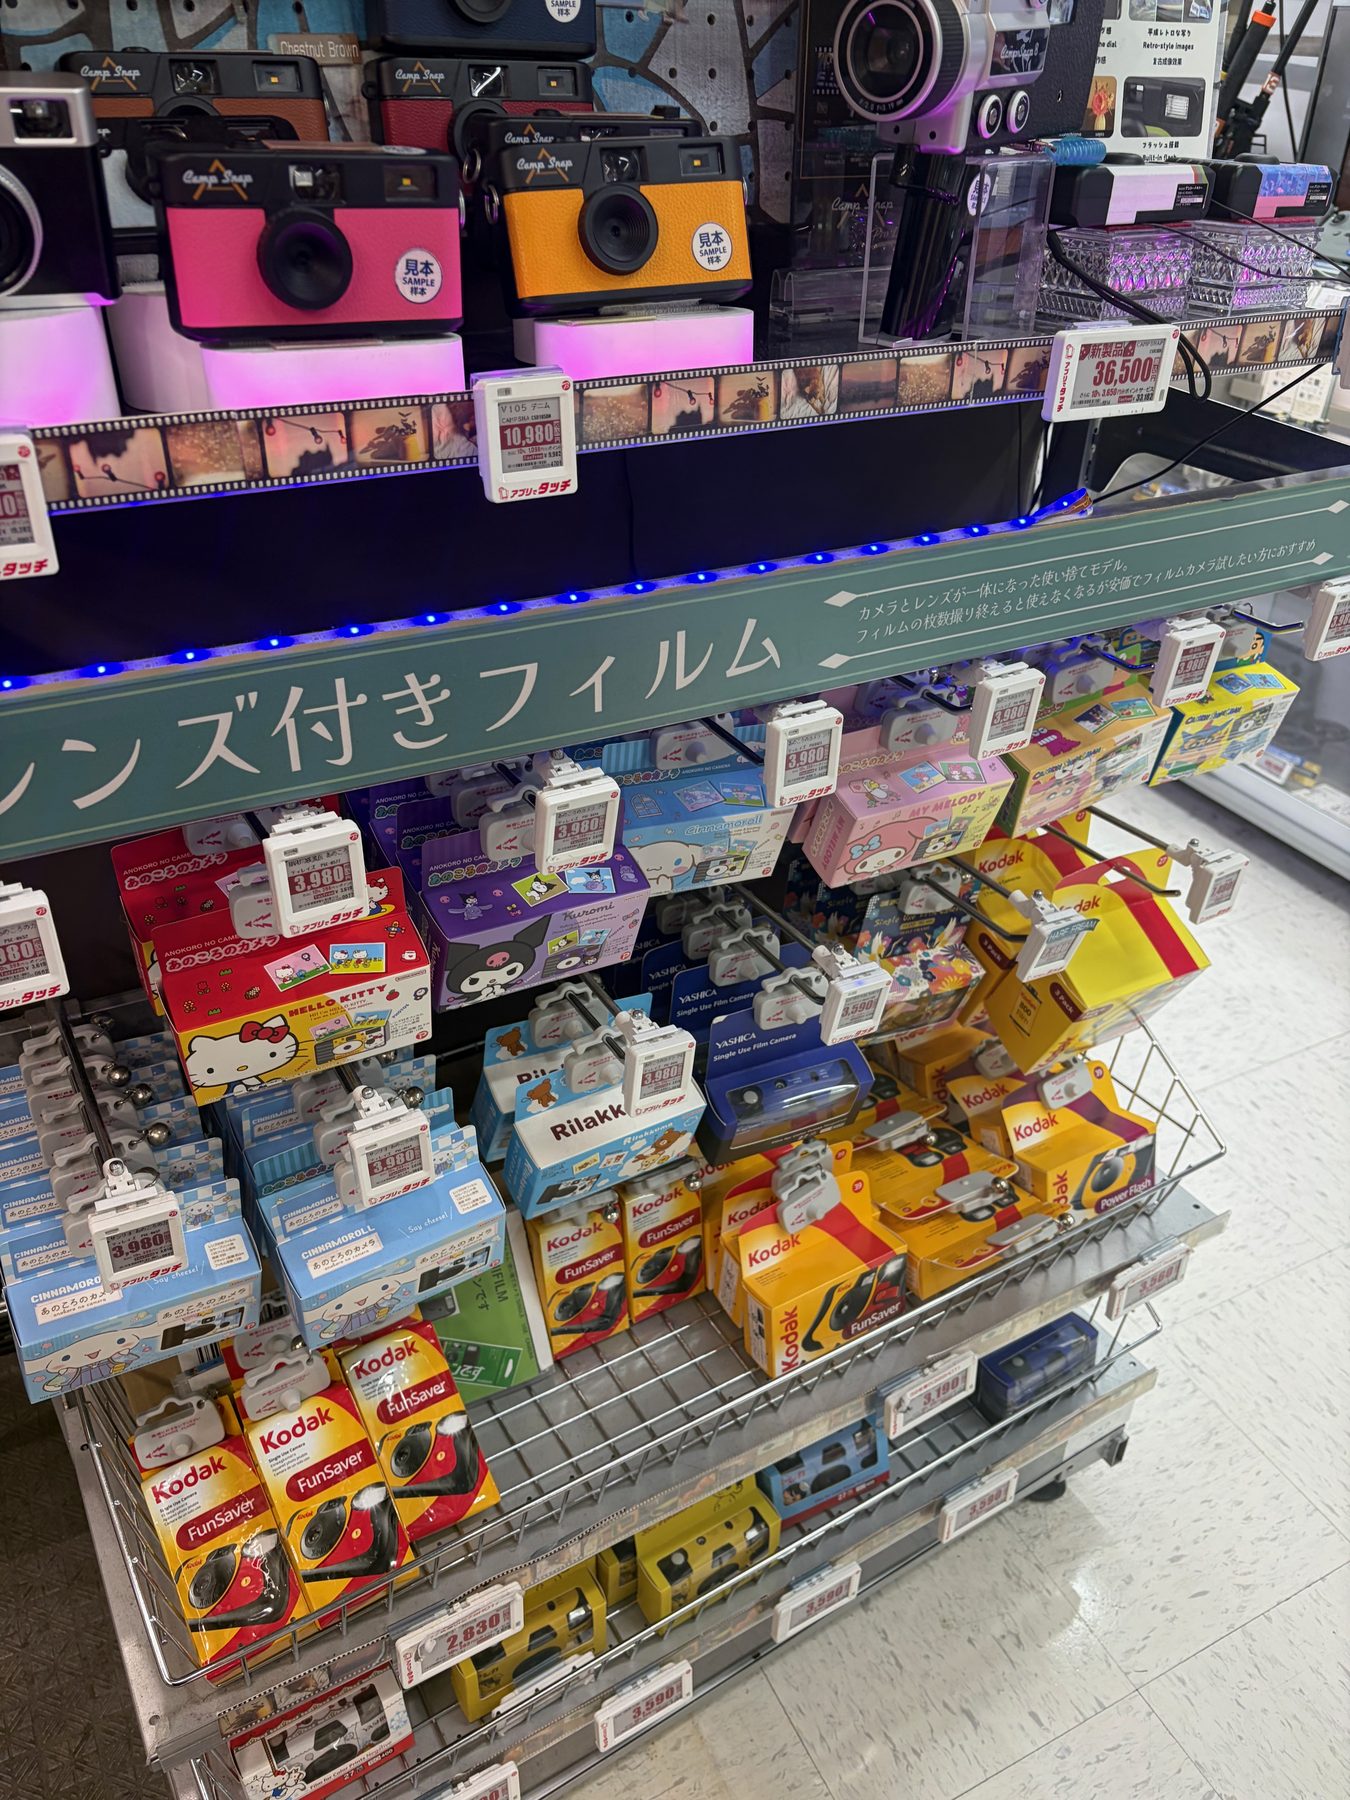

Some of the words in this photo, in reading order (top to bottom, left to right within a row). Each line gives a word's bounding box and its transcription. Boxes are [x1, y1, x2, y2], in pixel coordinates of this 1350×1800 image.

[280, 41, 324, 57] Chestnut
[327, 41, 360, 57] Brown
[1143, 42, 1174, 51] Retro-style
[1175, 43, 1194, 51] images
[81, 66, 112, 81] Camp
[113, 67, 140, 80] Snap
[395, 69, 419, 81] Camp
[420, 69, 445, 81] Snap
[183, 171, 218, 186] Camp
[221, 171, 253, 186] Snap
[517, 159, 545, 173] Camp
[548, 159, 573, 173] Snap
[699, 231, 725, 247] 見本
[699, 245, 727, 257] SAMPLE
[405, 259, 435, 276] 見本
[402, 276, 435, 288] SAMPLE
[1090, 342, 1123, 358] 新製品
[1093, 357, 1153, 386] 36,500
[504, 423, 554, 446] 10,980
[510, 479, 572, 498] アプリでタッチ
[857, 538, 1316, 644] フィルムの枚数撮り終えると使えなくなるが安価でフィルムカメラ試したい方におすすめ
[859, 557, 1128, 623] カメラとレンズが一体になった使い捨てモデル。
[994, 704, 1024, 724] 3,980
[788, 747, 824, 768] 3,980
[909, 806, 931, 818] MY
[933, 790, 985, 812] MELODY
[559, 818, 599, 838] 3,980
[684, 815, 763, 835] Cinnamoroll
[123, 859, 158, 876] ANOKORO
[159, 857, 172, 867] NO
[174, 851, 191, 864] CAME
[125, 851, 228, 890] あのころのカメラ
[429, 860, 462, 872] ANOKORO
[979, 850, 1024, 874] Kodak
[295, 865, 344, 892] 3,980
[302, 907, 363, 932] アプリでタッチ
[562, 902, 615, 922] Kuromi
[164, 945, 202, 958] ANOKORO
[204, 939, 217, 949] NO
[218, 933, 240, 946] CAME
[165, 934, 281, 973] あのころのカメラ
[648, 964, 687, 980] YASHICA
[288, 998, 337, 1018] HELLO
[339, 984, 388, 1003] KITTY
[676, 1006, 698, 1017] Single
[699, 1002, 712, 1011] Use
[713, 999, 728, 1008] Film
[728, 992, 754, 1003] Camera
[679, 989, 718, 1004] YASHICA
[1055, 989, 1060, 997] 3
[1059, 993, 1074, 1014] Pack
[713, 1048, 736, 1062] Single
[737, 1043, 751, 1052] Use
[752, 1038, 768, 1049] Film
[769, 1033, 797, 1045] Camera
[715, 1032, 757, 1049] YASHICA
[644, 1065, 678, 1086] 3,980
[961, 1082, 1010, 1109] Kodak
[550, 1104, 627, 1141] Rilakk
[623, 1121, 674, 1145] Rilakkuma
[1013, 1112, 1059, 1142] Kodak
[373, 1149, 415, 1173] 3,980
[379, 1177, 430, 1202] アプリでタッチ
[1100, 1189, 1129, 1210] Power
[1128, 1179, 1152, 1197] Flash
[632, 1188, 683, 1217] Kodak
[288, 1203, 339, 1228] あのころのカメラ
[408, 1223, 423, 1234] Say
[423, 1212, 449, 1228] cheese!
[546, 1221, 604, 1252] Kodak
[646, 1214, 695, 1243] FunSaver
[112, 1233, 164, 1258] 3,980
[301, 1224, 376, 1260] CINNAMOROLL
[312, 1239, 377, 1270] あのころのカメラ
[420, 1227, 493, 1265] あのころのカメラ
[747, 1234, 801, 1268] Kodak
[122, 1263, 182, 1288] アプリでタッチ
[153, 1274, 170, 1285] Say
[171, 1265, 199, 1281] cheese!
[563, 1250, 615, 1280] FunSaver
[31, 1276, 101, 1304] CINNAMORO
[41, 1291, 107, 1316] あのころのカメ
[162, 1286, 248, 1320] あのころのカメラ
[851, 1302, 901, 1335] FunSaver
[780, 1305, 799, 1373] Kodak
[352, 1339, 420, 1380] Kodak
[386, 1380, 446, 1417] FunSaver
[923, 1376, 960, 1406] 3,190
[259, 1406, 335, 1456] Kodak
[268, 1454, 281, 1463] Single
[289, 1442, 306, 1453] Camera
[151, 1455, 227, 1505] Kodak
[296, 1450, 363, 1493] FunSaver
[188, 1498, 255, 1542] FunSaver
[296, 1510, 314, 1521] Kodak
[447, 1612, 500, 1652] 2,830
[632, 1686, 675, 1720] 3,590
[381, 1748, 394, 1759] 400
[310, 1781, 323, 1790] Film
[324, 1775, 333, 1783] for
[333, 1765, 349, 1779] Color
[349, 1756, 366, 1769] Prints
[343, 1769, 355, 1781] 27
